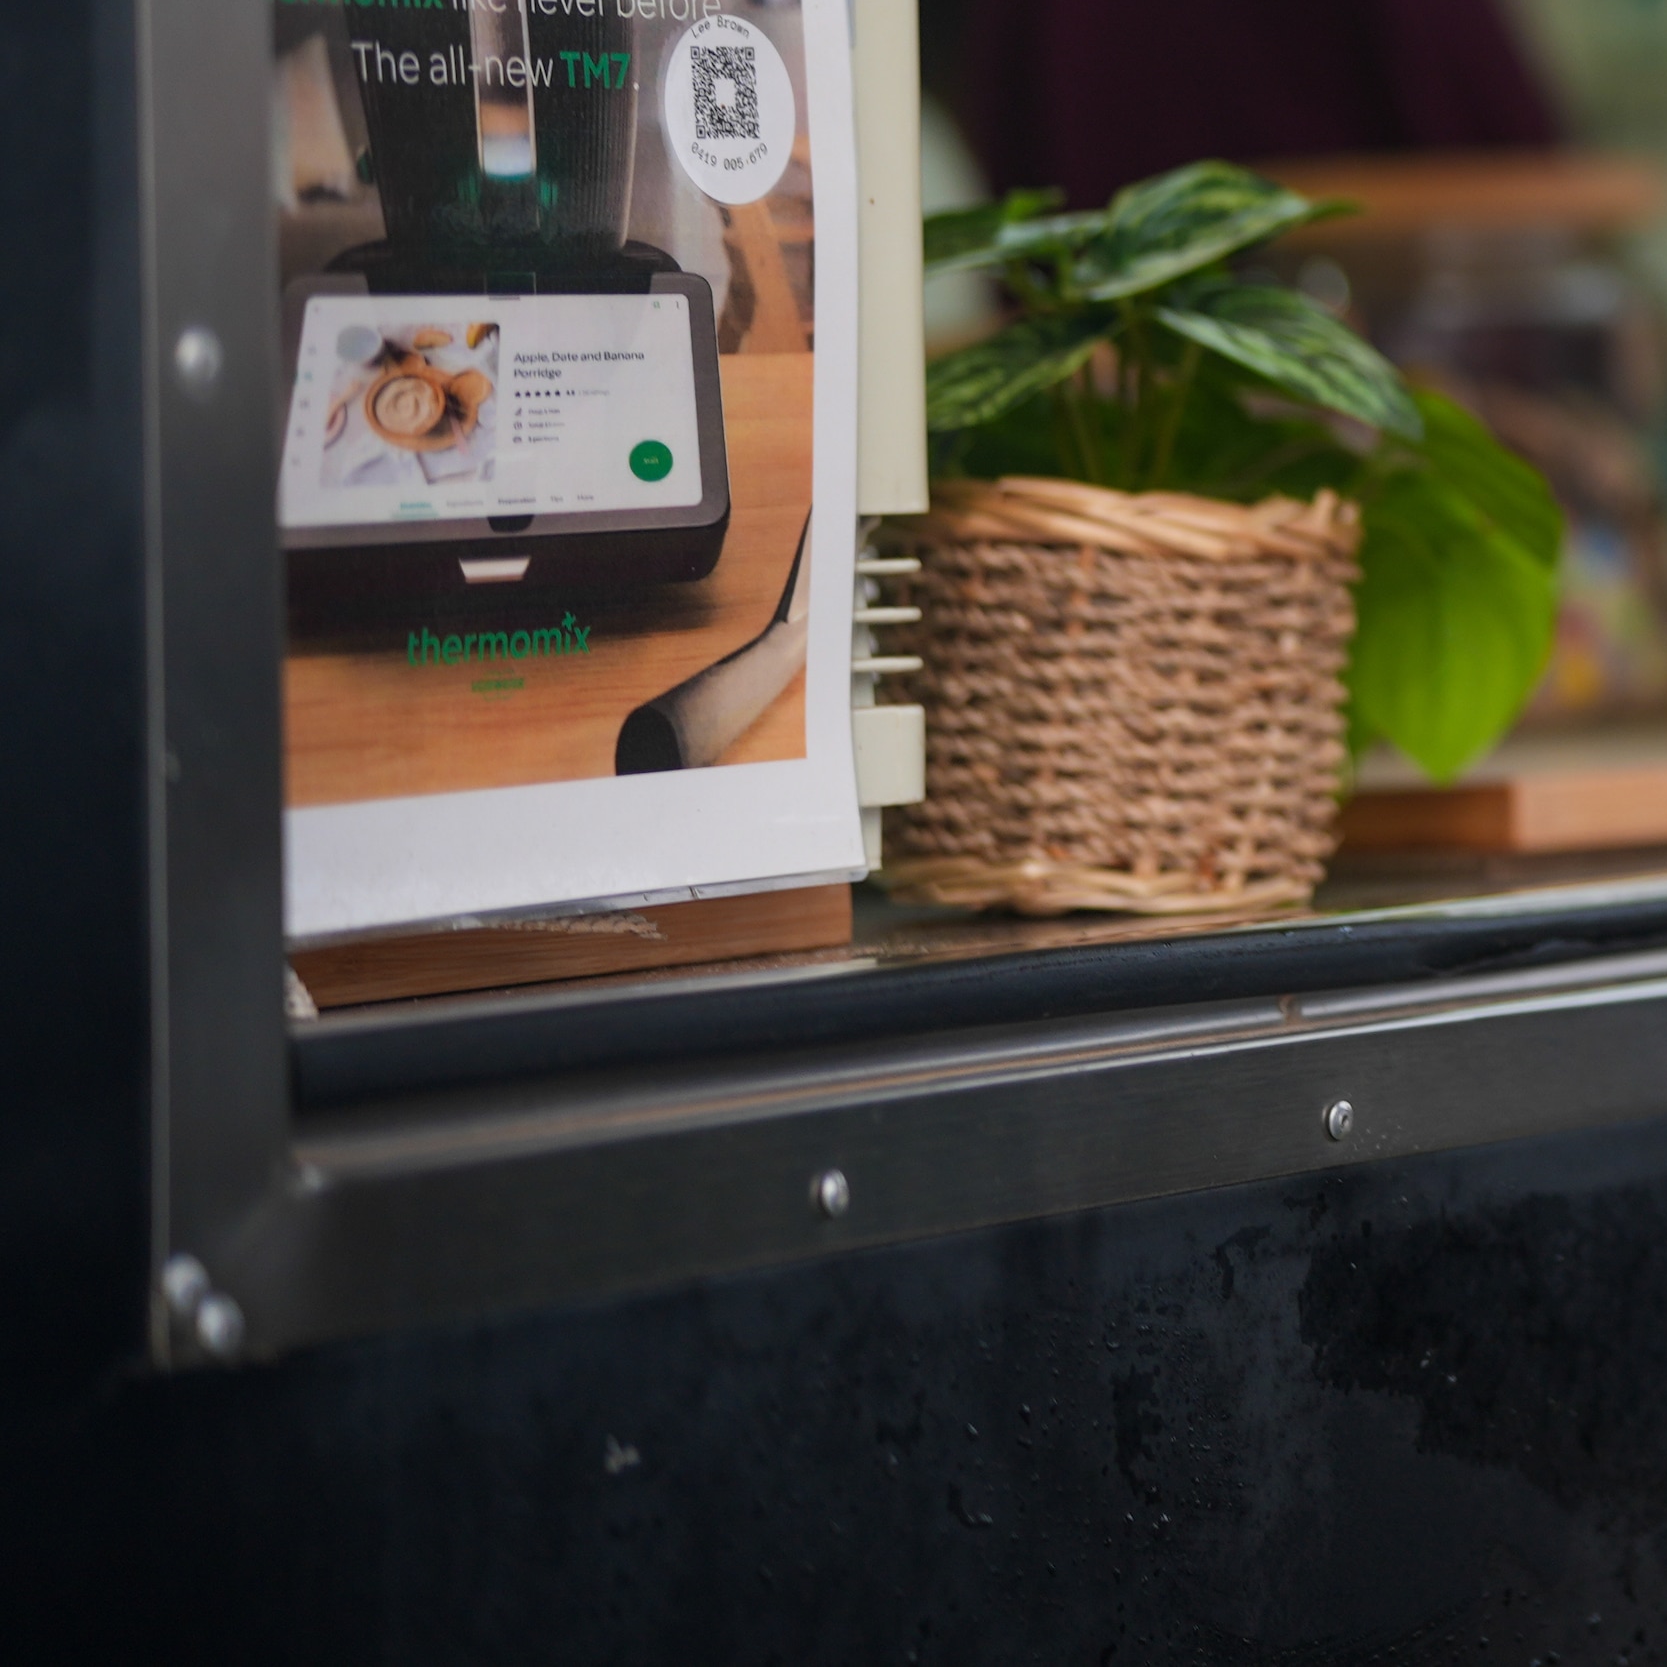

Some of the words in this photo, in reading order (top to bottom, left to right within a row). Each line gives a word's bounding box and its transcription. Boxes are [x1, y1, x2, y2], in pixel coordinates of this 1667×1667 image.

[690, 20, 711, 39] Lee
[717, 14, 751, 39] Brown
[351, 41, 420, 85] The
[428, 42, 554, 89] all-new
[691, 141, 718, 167] 0419
[723, 157, 745, 172] 005
[749, 141, 769, 165] 679
[551, 351, 579, 362] Date
[580, 350, 602, 362] and
[603, 350, 645, 361] Banana
[513, 367, 562, 380] Porridge
[407, 610, 591, 667] thermomix
